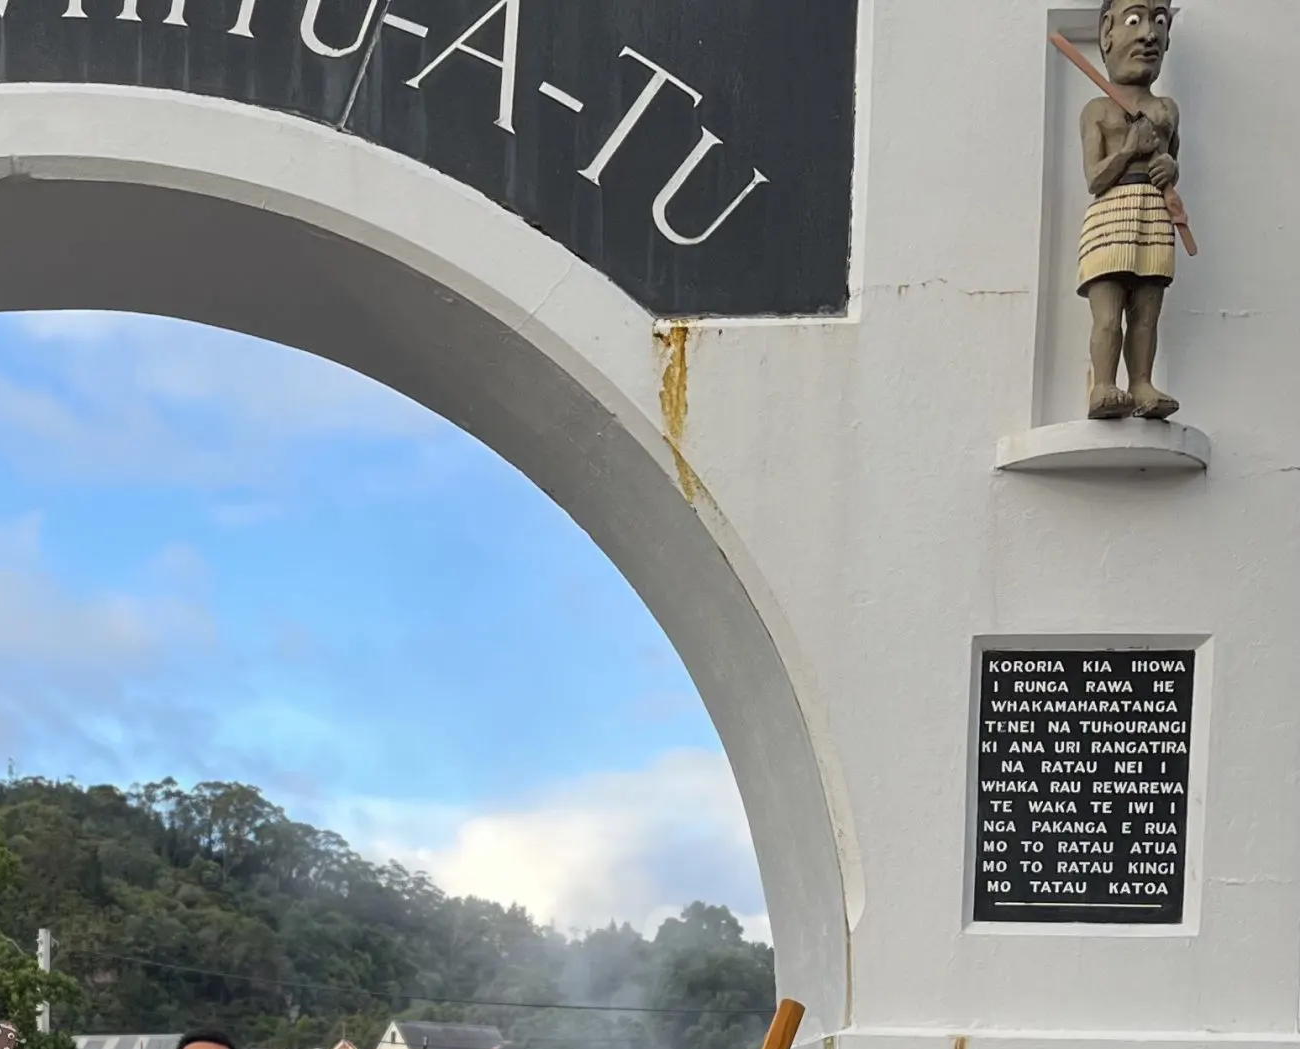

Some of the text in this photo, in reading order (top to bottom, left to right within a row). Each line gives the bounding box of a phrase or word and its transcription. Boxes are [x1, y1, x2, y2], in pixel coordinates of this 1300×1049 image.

[989, 661, 1185, 672] KORORIA KIA IHOWA
[994, 681, 1174, 693] I RUNGA RAWA HE
[991, 700, 1177, 712] WHAKAMAHARATANGA
[985, 721, 1186, 733] TENEI NA TUHOURANGI
[982, 741, 1187, 753] KI ANA URI RANGATIRA
[1002, 760, 1166, 774] NA RATAU NEI I
[981, 781, 1184, 794] WHAKA RAU REWAREWA
[990, 800, 1175, 814] TE WAKA TE IWI I
[984, 820, 1177, 834] NGA PAKANGA E RUA
[983, 841, 1177, 854] MO TO RATAU ATUA
[983, 860, 1174, 874] MO TO RATAU KINGI
[987, 881, 1168, 895] MO TATAU KATOA
